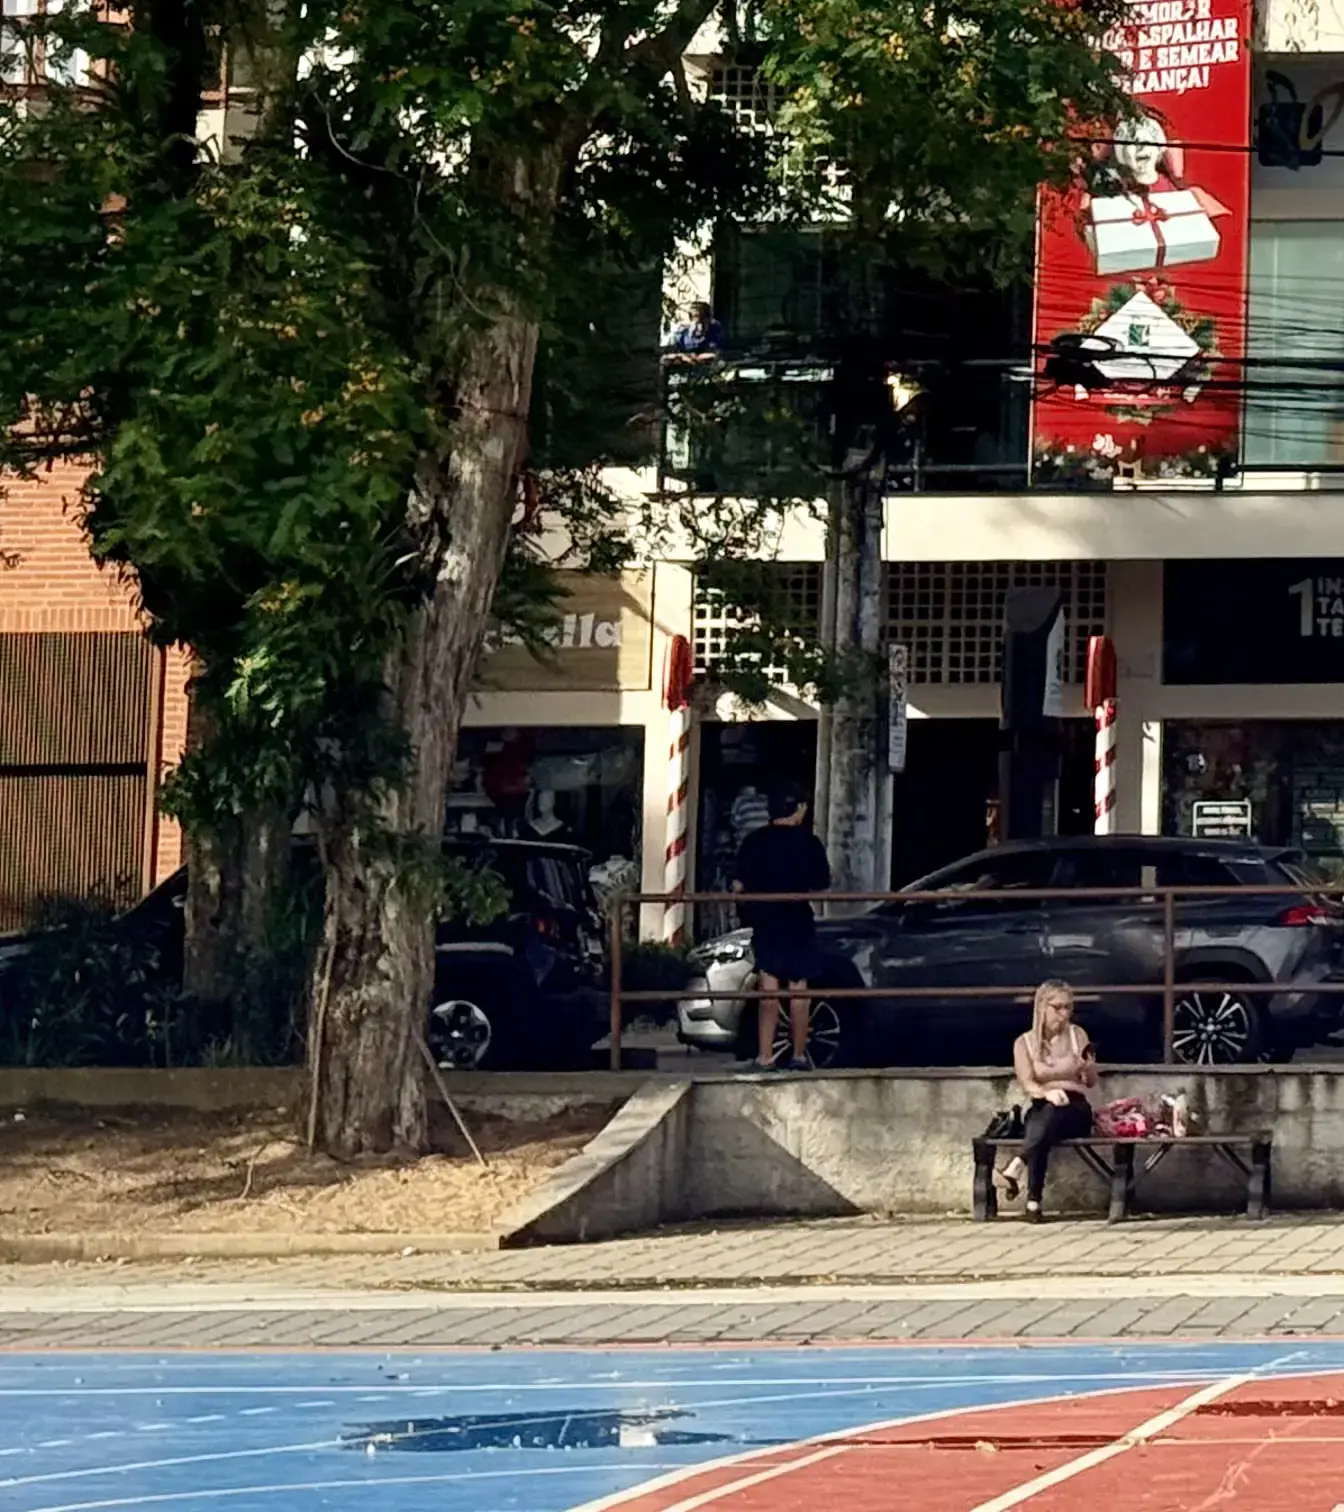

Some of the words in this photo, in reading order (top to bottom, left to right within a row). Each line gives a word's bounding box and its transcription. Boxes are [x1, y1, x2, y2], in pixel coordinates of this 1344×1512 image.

[1138, 18, 1238, 47] ESPALHAR
[1157, 40, 1239, 69] SEMEAR
[1316, 617, 1344, 637] TE
